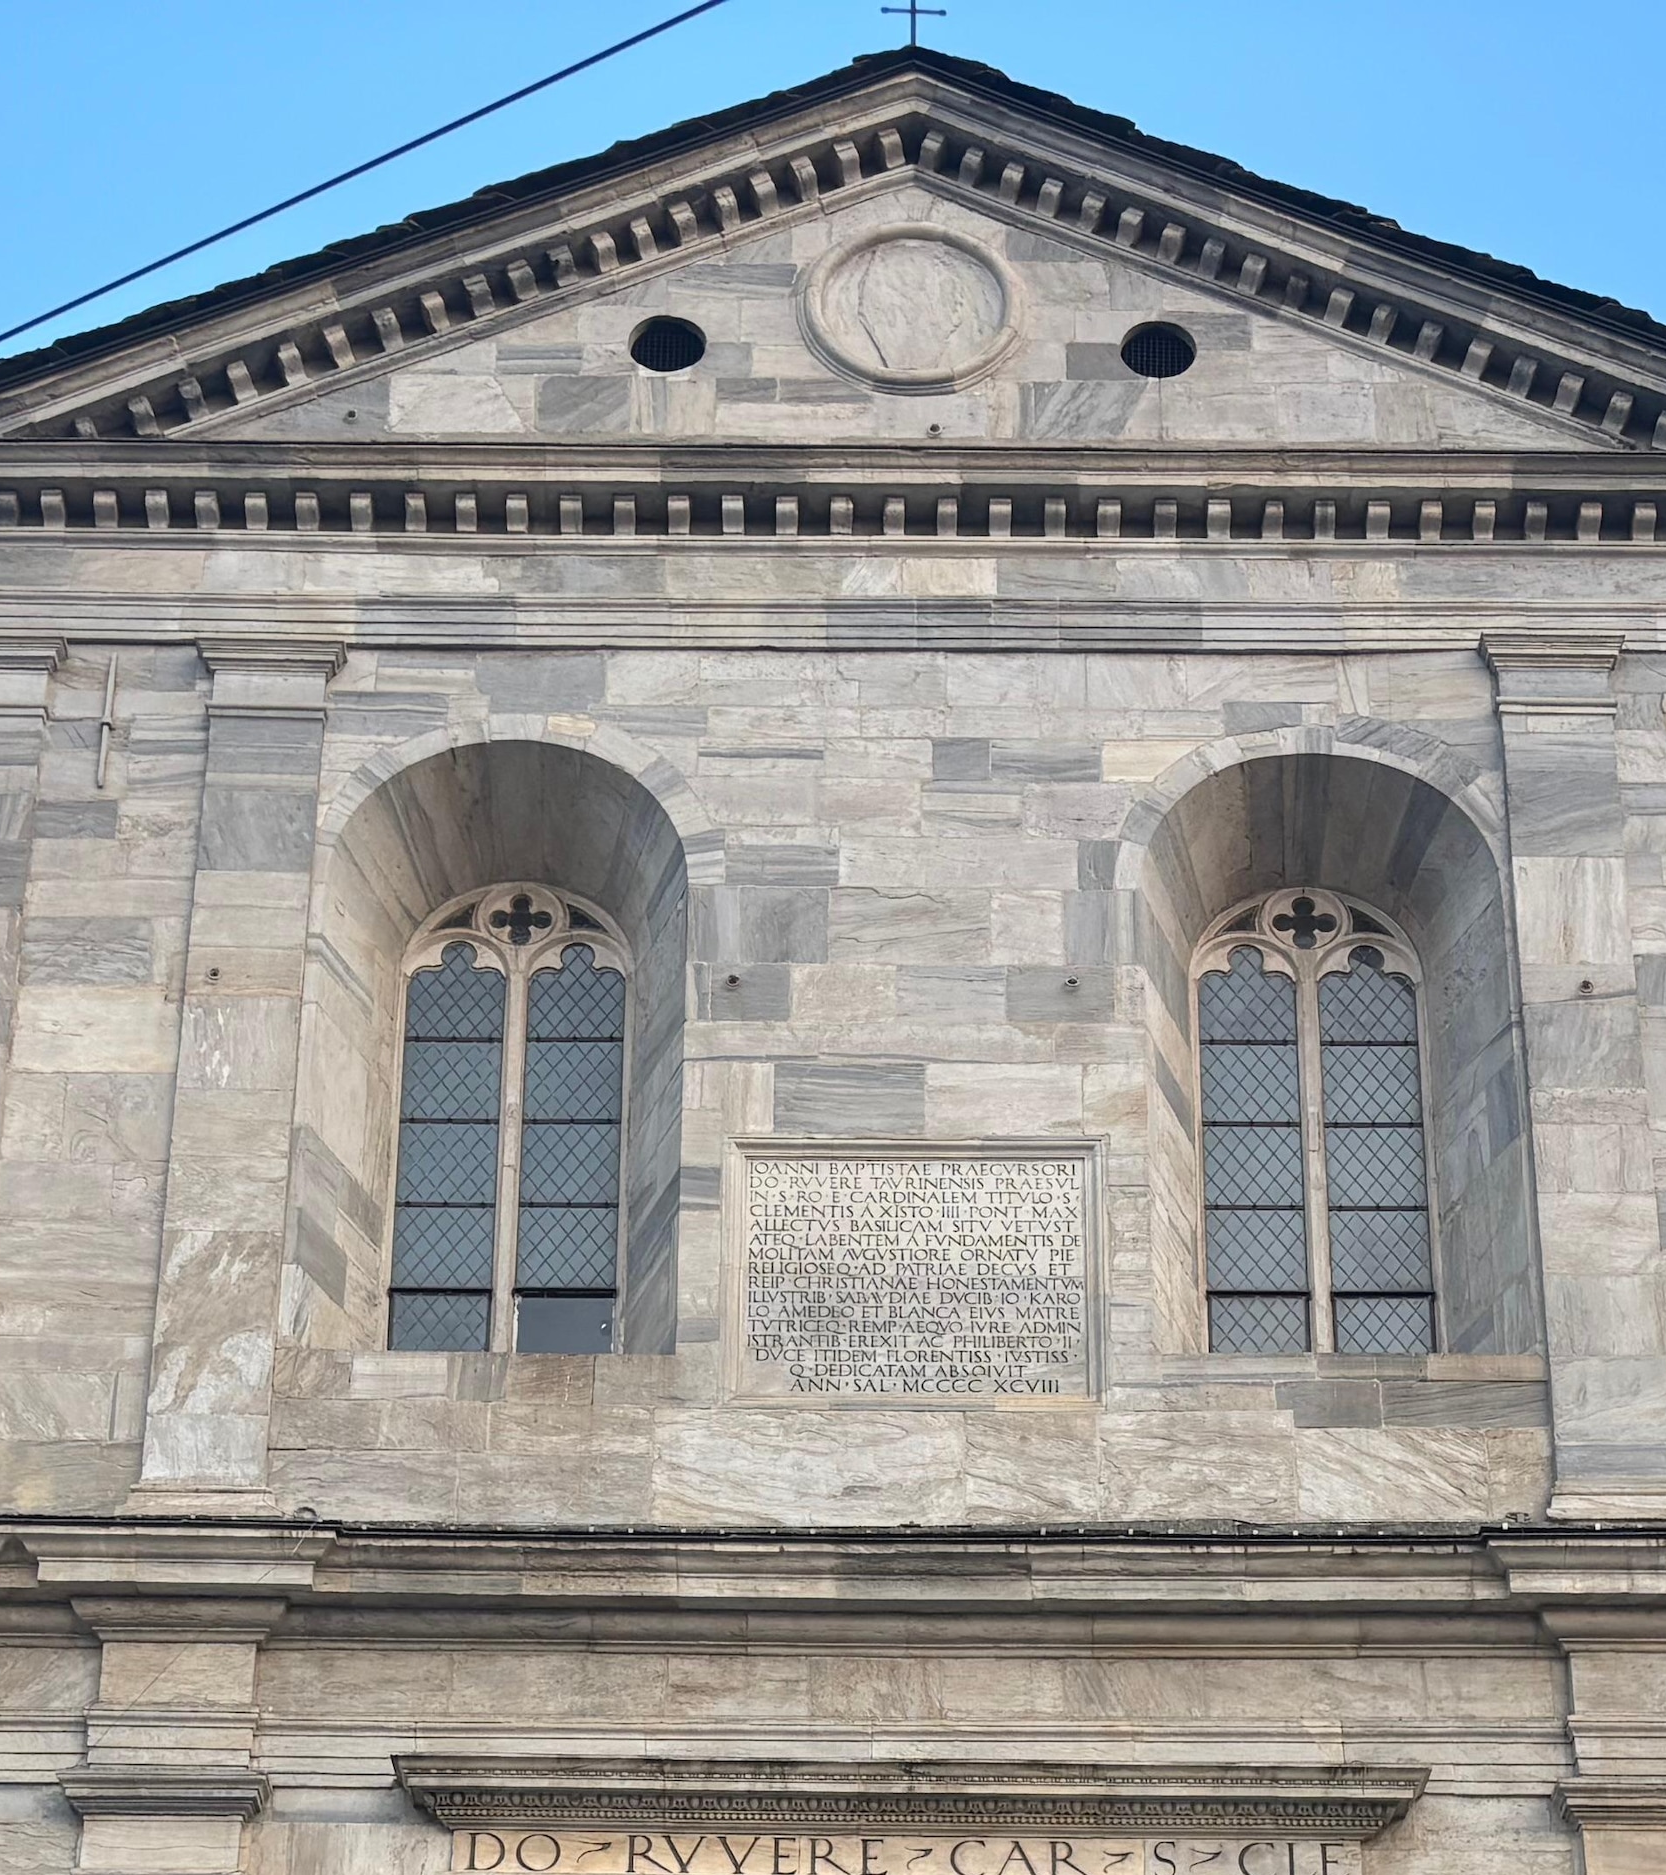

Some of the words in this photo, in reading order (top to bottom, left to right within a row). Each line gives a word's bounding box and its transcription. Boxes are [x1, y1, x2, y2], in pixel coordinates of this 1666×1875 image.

[750, 1162, 819, 1174] IOANNI
[829, 1163, 931, 1175] BAPTISTAE
[941, 1163, 1075, 1176] PRAECVRSORI
[750, 1176, 778, 1188] DO
[790, 1177, 861, 1189] RVVERE
[995, 1178, 1079, 1190] PRAESVL
[750, 1191, 768, 1202] IN
[779, 1191, 786, 1202] S
[798, 1191, 822, 1203] RO
[833, 1192, 840, 1203] E
[850, 1192, 977, 1204] CARDINALEM
[985, 1192, 1052, 1204] TITVLO
[1063, 1192, 1070, 1204] S
[750, 1205, 853, 1218] CLEMENTIS
[861, 1204, 874, 1218] A
[970, 1206, 1022, 1218] PONT
[1033, 1207, 1078, 1218] MAX
[953, 1221, 991, 1232] SITV
[1002, 1221, 1075, 1232] VETVST
[806, 1234, 899, 1246] LABENTEM
[907, 1234, 919, 1246] A
[926, 1235, 1053, 1246] FVNDAMENTIS
[1062, 1235, 1081, 1246] DE
[961, 1249, 1037, 1261] ORNATV
[1050, 1250, 1075, 1261] PIE
[858, 1263, 885, 1275] AD
[896, 1263, 967, 1276] PATRIAE
[978, 1264, 1037, 1276] DECVS
[1049, 1264, 1071, 1276] ET
[749, 1276, 784, 1289] REIP
[794, 1277, 918, 1289] CHRISTIANAE
[940, 1292, 992, 1305] DVCIB
[1002, 1293, 1019, 1305] IO
[1031, 1293, 1081, 1305] KARO
[748, 1305, 769, 1317] LO
[778, 1306, 854, 1318] AMEDEO
[862, 1306, 883, 1318] ET
[889, 1306, 960, 1319] BLANCA
[970, 1307, 1005, 1319] EIVS
[1016, 1307, 1079, 1319] MATRE
[849, 1321, 897, 1333] REMP
[903, 1321, 962, 1335] AEQVO
[971, 1321, 1011, 1333] IVRE
[1020, 1322, 1081, 1334] ADMIN
[849, 1335, 911, 1347] EREXIT
[919, 1336, 943, 1348] AC
[953, 1336, 1052, 1348] PHILIBERTO
[756, 1349, 805, 1361] DVCE
[814, 1350, 876, 1362] ITIDEM
[1005, 1351, 1068, 1363] IVSTISS
[790, 1364, 811, 1378] Q
[815, 1364, 926, 1377] DEDICATAM
[790, 1379, 840, 1391] ANN
[854, 1379, 890, 1392] SAL
[903, 1380, 983, 1392] MCCCC
[994, 1380, 1059, 1393] XCVIII
[464, 1832, 561, 1872] DO
